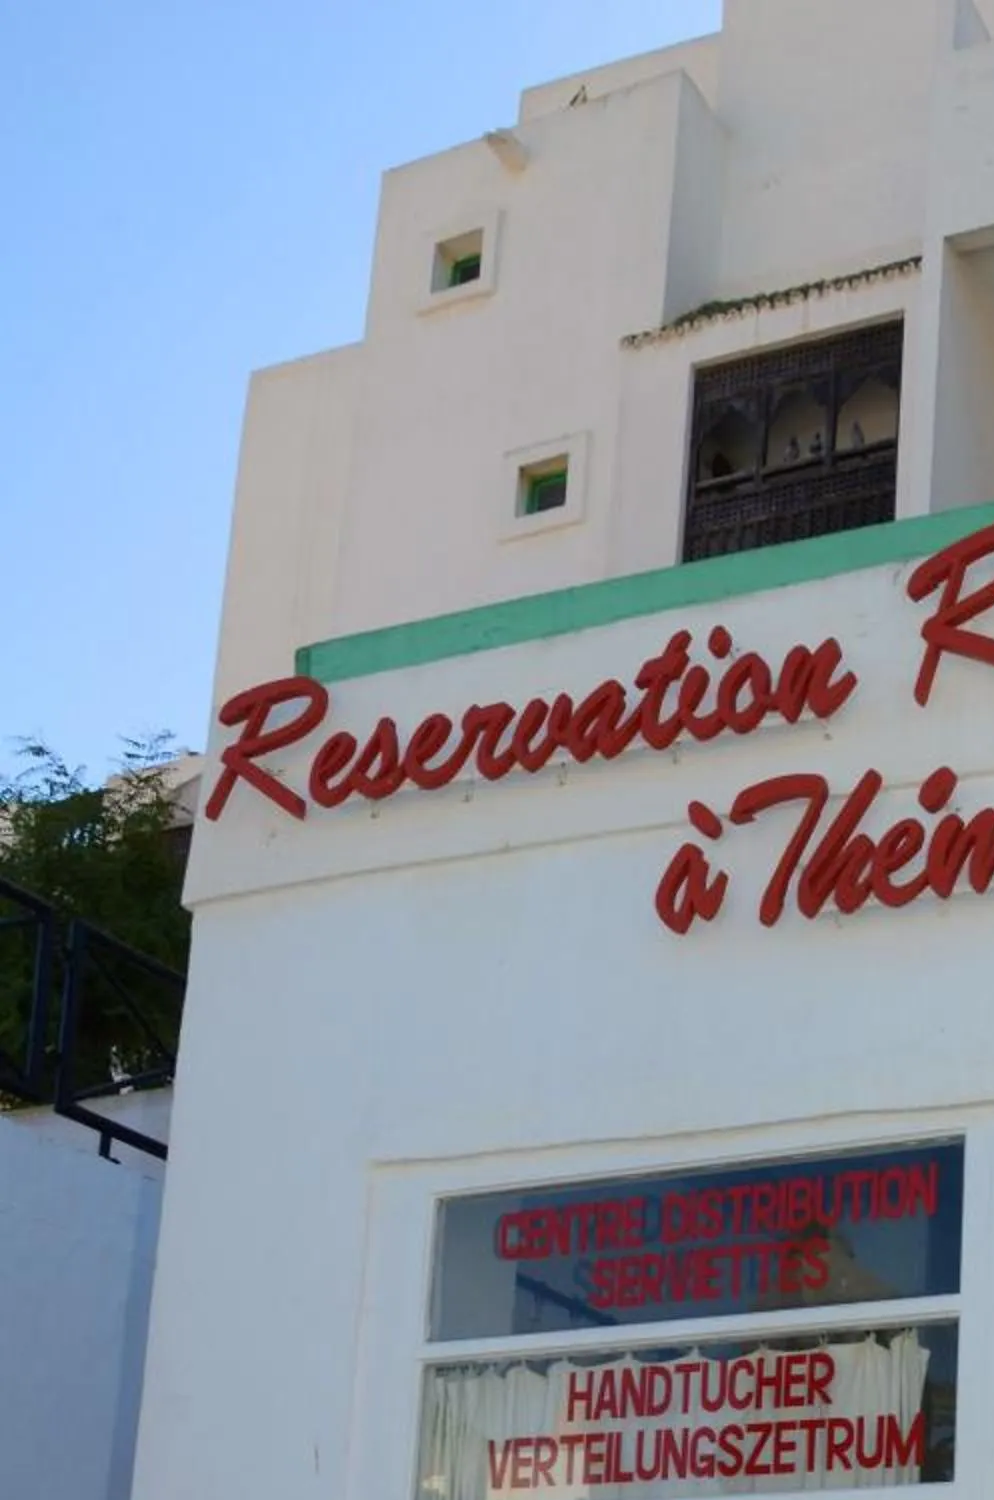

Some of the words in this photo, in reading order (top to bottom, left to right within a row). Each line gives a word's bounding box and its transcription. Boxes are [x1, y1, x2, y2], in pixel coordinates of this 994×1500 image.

[205, 624, 858, 822] Reservation
[497, 1196, 646, 1261] CENTRE
[661, 1161, 939, 1245] DISTRIBUTION
[588, 1236, 831, 1309] SERVIETTES
[566, 1351, 836, 1423] HANDTUCHER
[487, 1408, 927, 1491] VERTEILUNGSZETRUM
